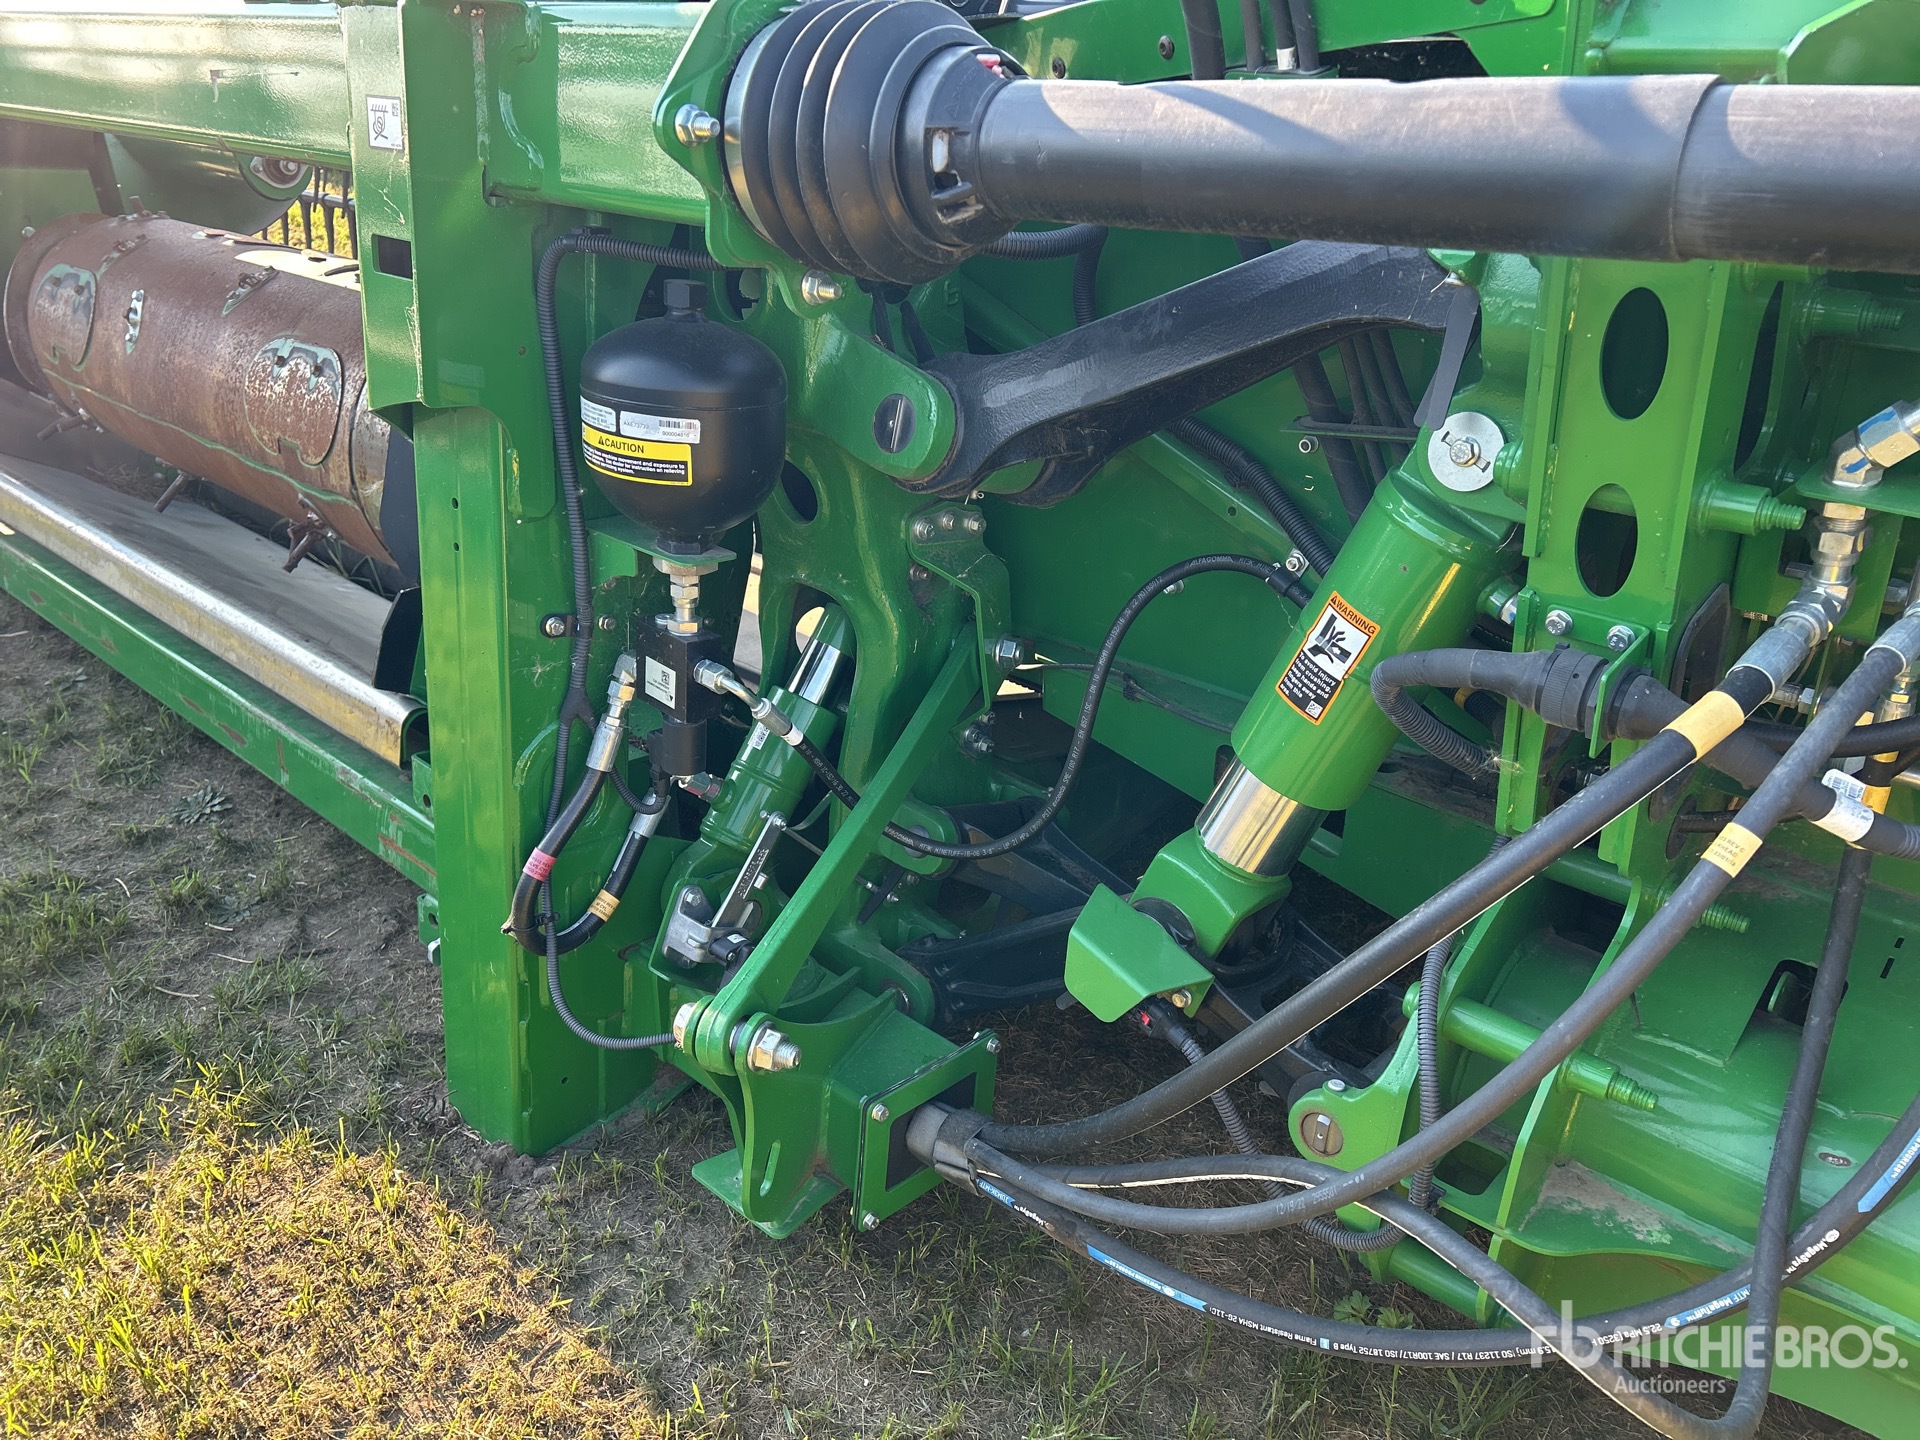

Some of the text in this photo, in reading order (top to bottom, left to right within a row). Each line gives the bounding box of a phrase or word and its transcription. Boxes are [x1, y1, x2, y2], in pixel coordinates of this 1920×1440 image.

[604, 438, 645, 454] CAUTION
[653, 462, 678, 470] exposure
[1189, 555, 1234, 567] ALFAGOMMA
[1335, 600, 1377, 636] WARNING
[1304, 657, 1320, 674] avoid
[1317, 669, 1337, 687] injury
[1300, 674, 1318, 691] hands
[1316, 686, 1330, 700] and
[1305, 668, 1332, 695] crushing,
[1301, 684, 1317, 700] away
[1238, 1316, 1260, 1330] MSHA
[1645, 1322, 1663, 1335] 22.5
[1259, 1324, 1294, 1341] Resistant
[1623, 1327, 1644, 1339] MPa
[1293, 1333, 1317, 1346] Flame
[1340, 1342, 1357, 1354] Type
[1358, 1346, 1384, 1357] 18752
[1384, 1349, 1398, 1358] ISO
[1434, 1352, 1450, 1361] SAE
[1457, 1351, 1473, 1361] R17
[1474, 1350, 1501, 1360] 11237
